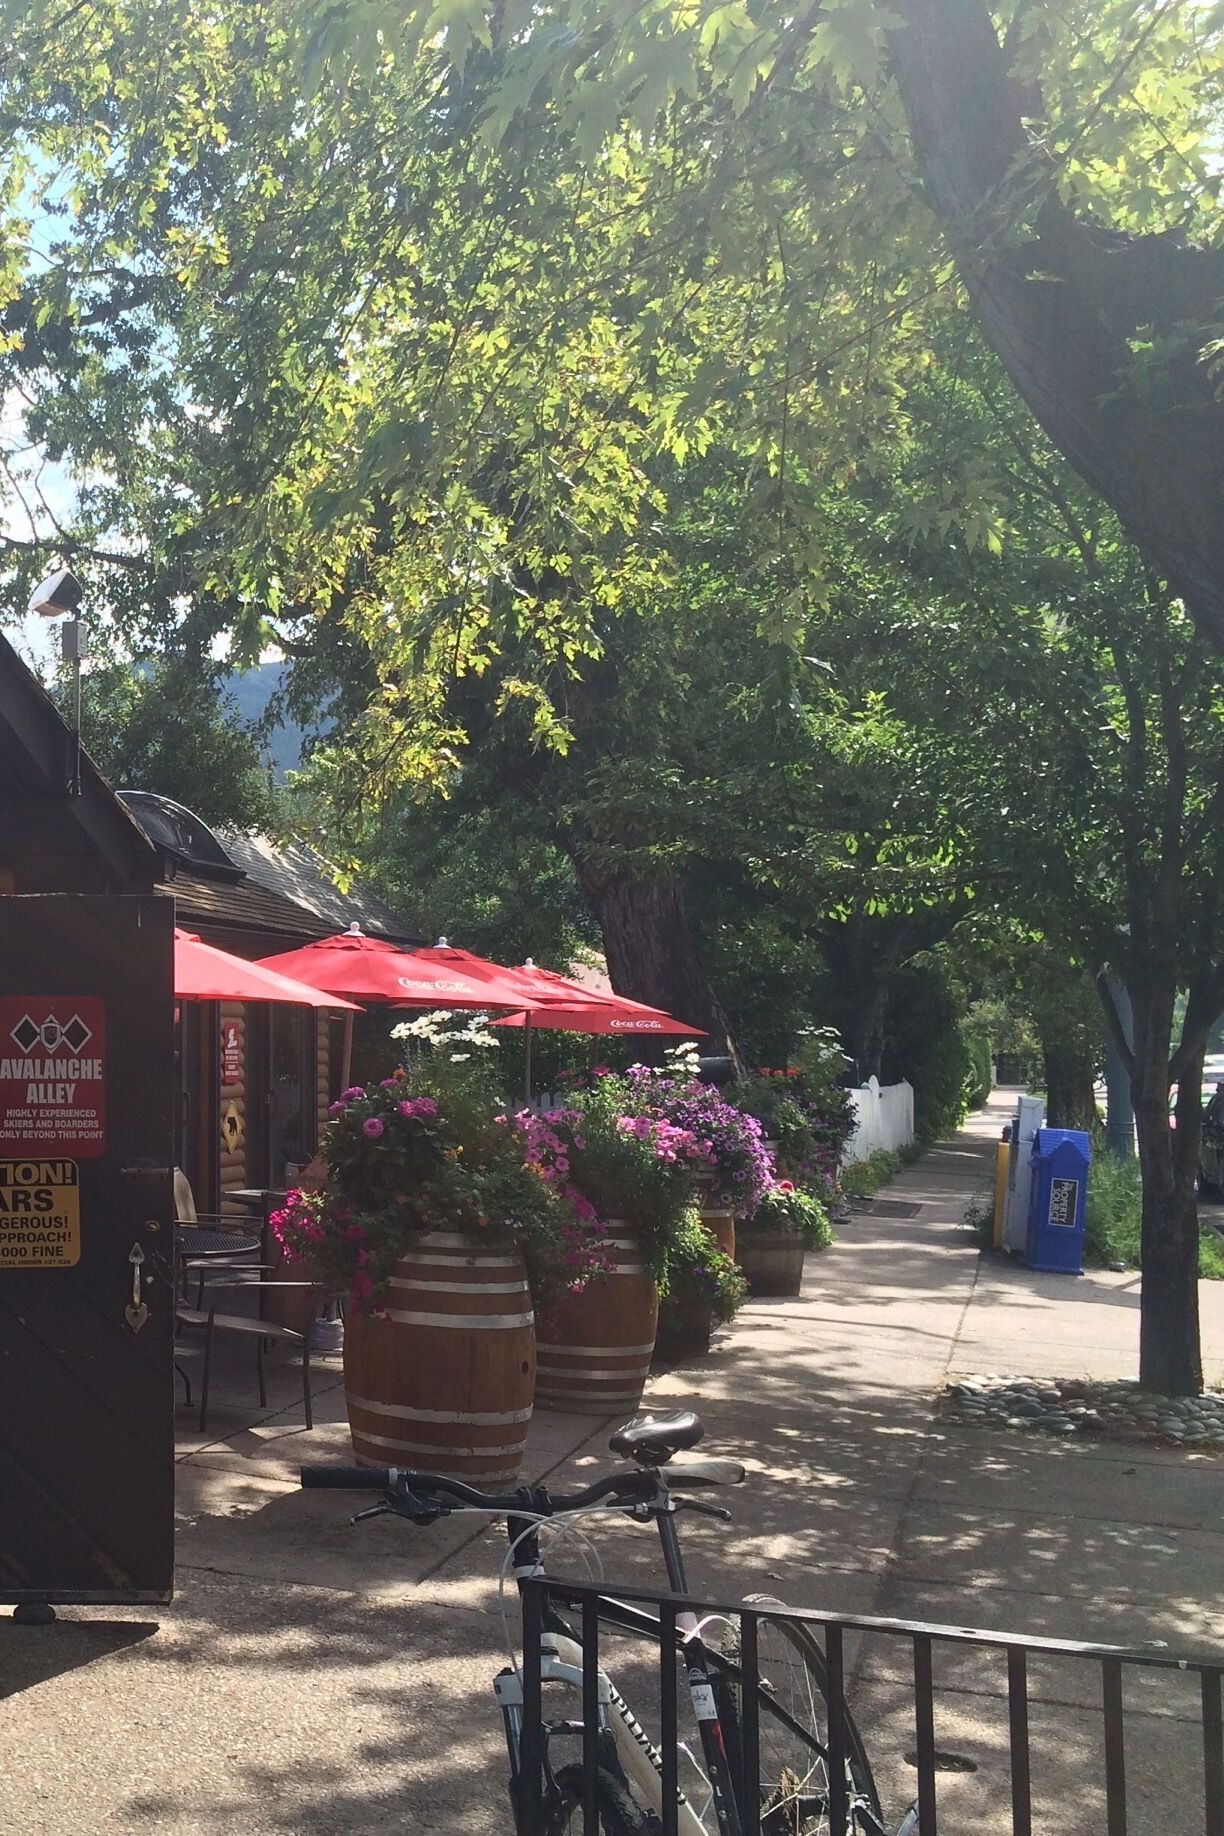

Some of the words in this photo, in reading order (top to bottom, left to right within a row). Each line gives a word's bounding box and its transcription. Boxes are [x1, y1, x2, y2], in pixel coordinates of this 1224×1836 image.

[397, 976, 475, 995] Coca-Cola
[609, 1018, 665, 1030] Coca-Cola
[0, 1058, 103, 1080] AVALANCHE
[26, 1083, 77, 1104] ALLEY
[6, 1109, 37, 1118] HIGHLY
[39, 1109, 96, 1118] EXPERIENCED
[3, 1119, 33, 1128] SKIERS
[35, 1119, 53, 1128] AND
[55, 1119, 99, 1128] BOARDERS
[0, 1130, 21, 1139] ONLY
[22, 1130, 56, 1139] BEYOND
[57, 1130, 77, 1139] THIS
[78, 1130, 104, 1139] POINT
[1050, 1188, 1061, 1222] SOURCE
[1059, 1182, 1069, 1223] PROPERTY
[32, 1246, 64, 1257] FINE
